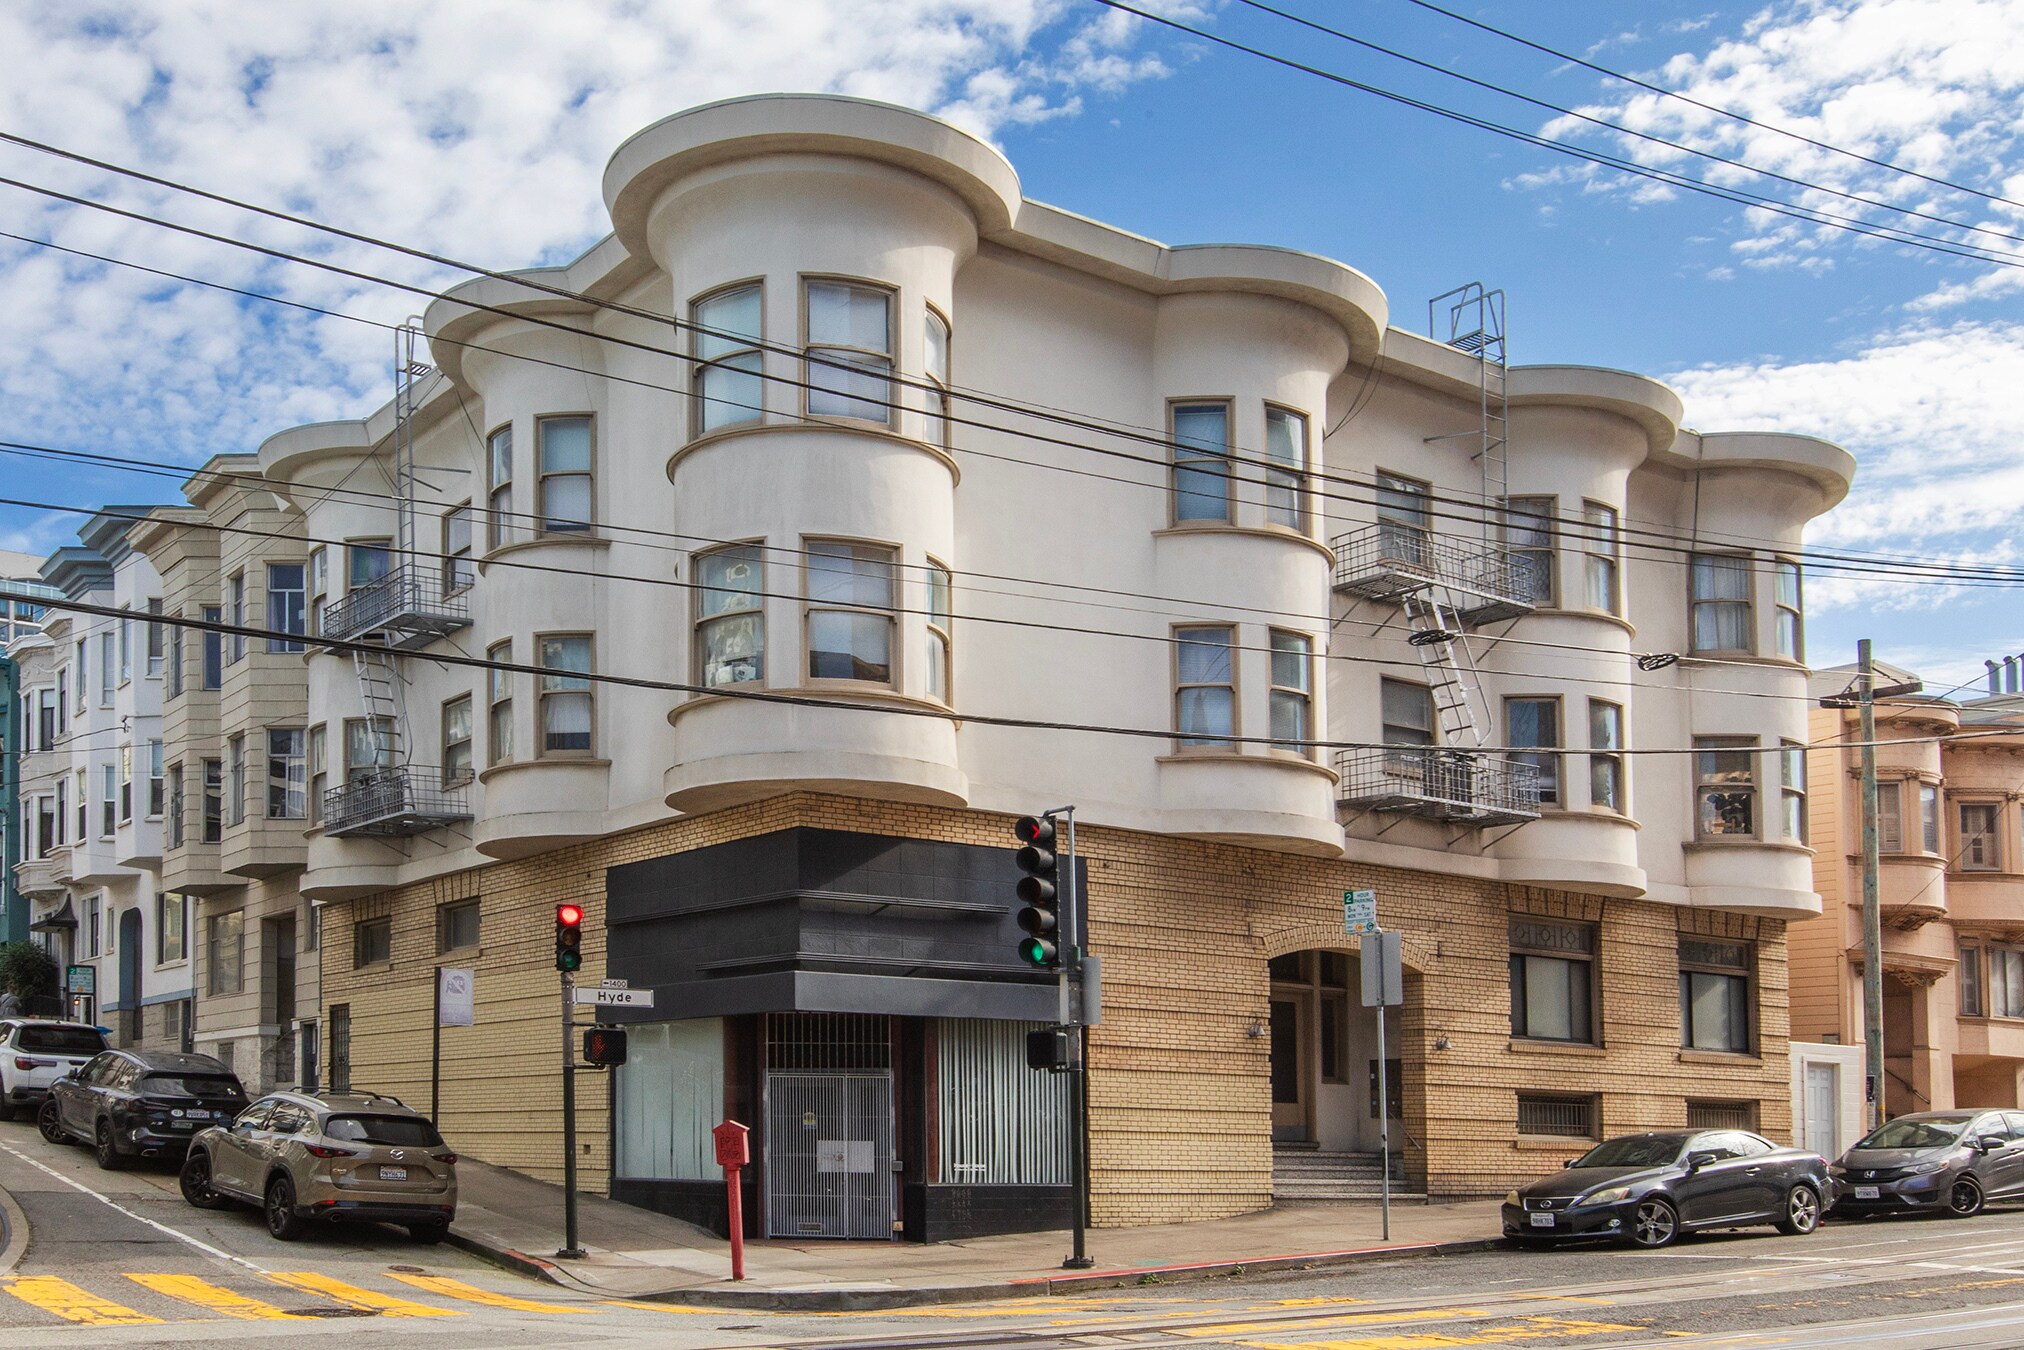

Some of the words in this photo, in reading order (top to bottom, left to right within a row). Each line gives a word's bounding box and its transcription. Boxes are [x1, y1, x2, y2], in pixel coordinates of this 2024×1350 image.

[1345, 893, 1352, 903] 2
[610, 980, 626, 988] 1400
[598, 991, 631, 1004] Hyde
